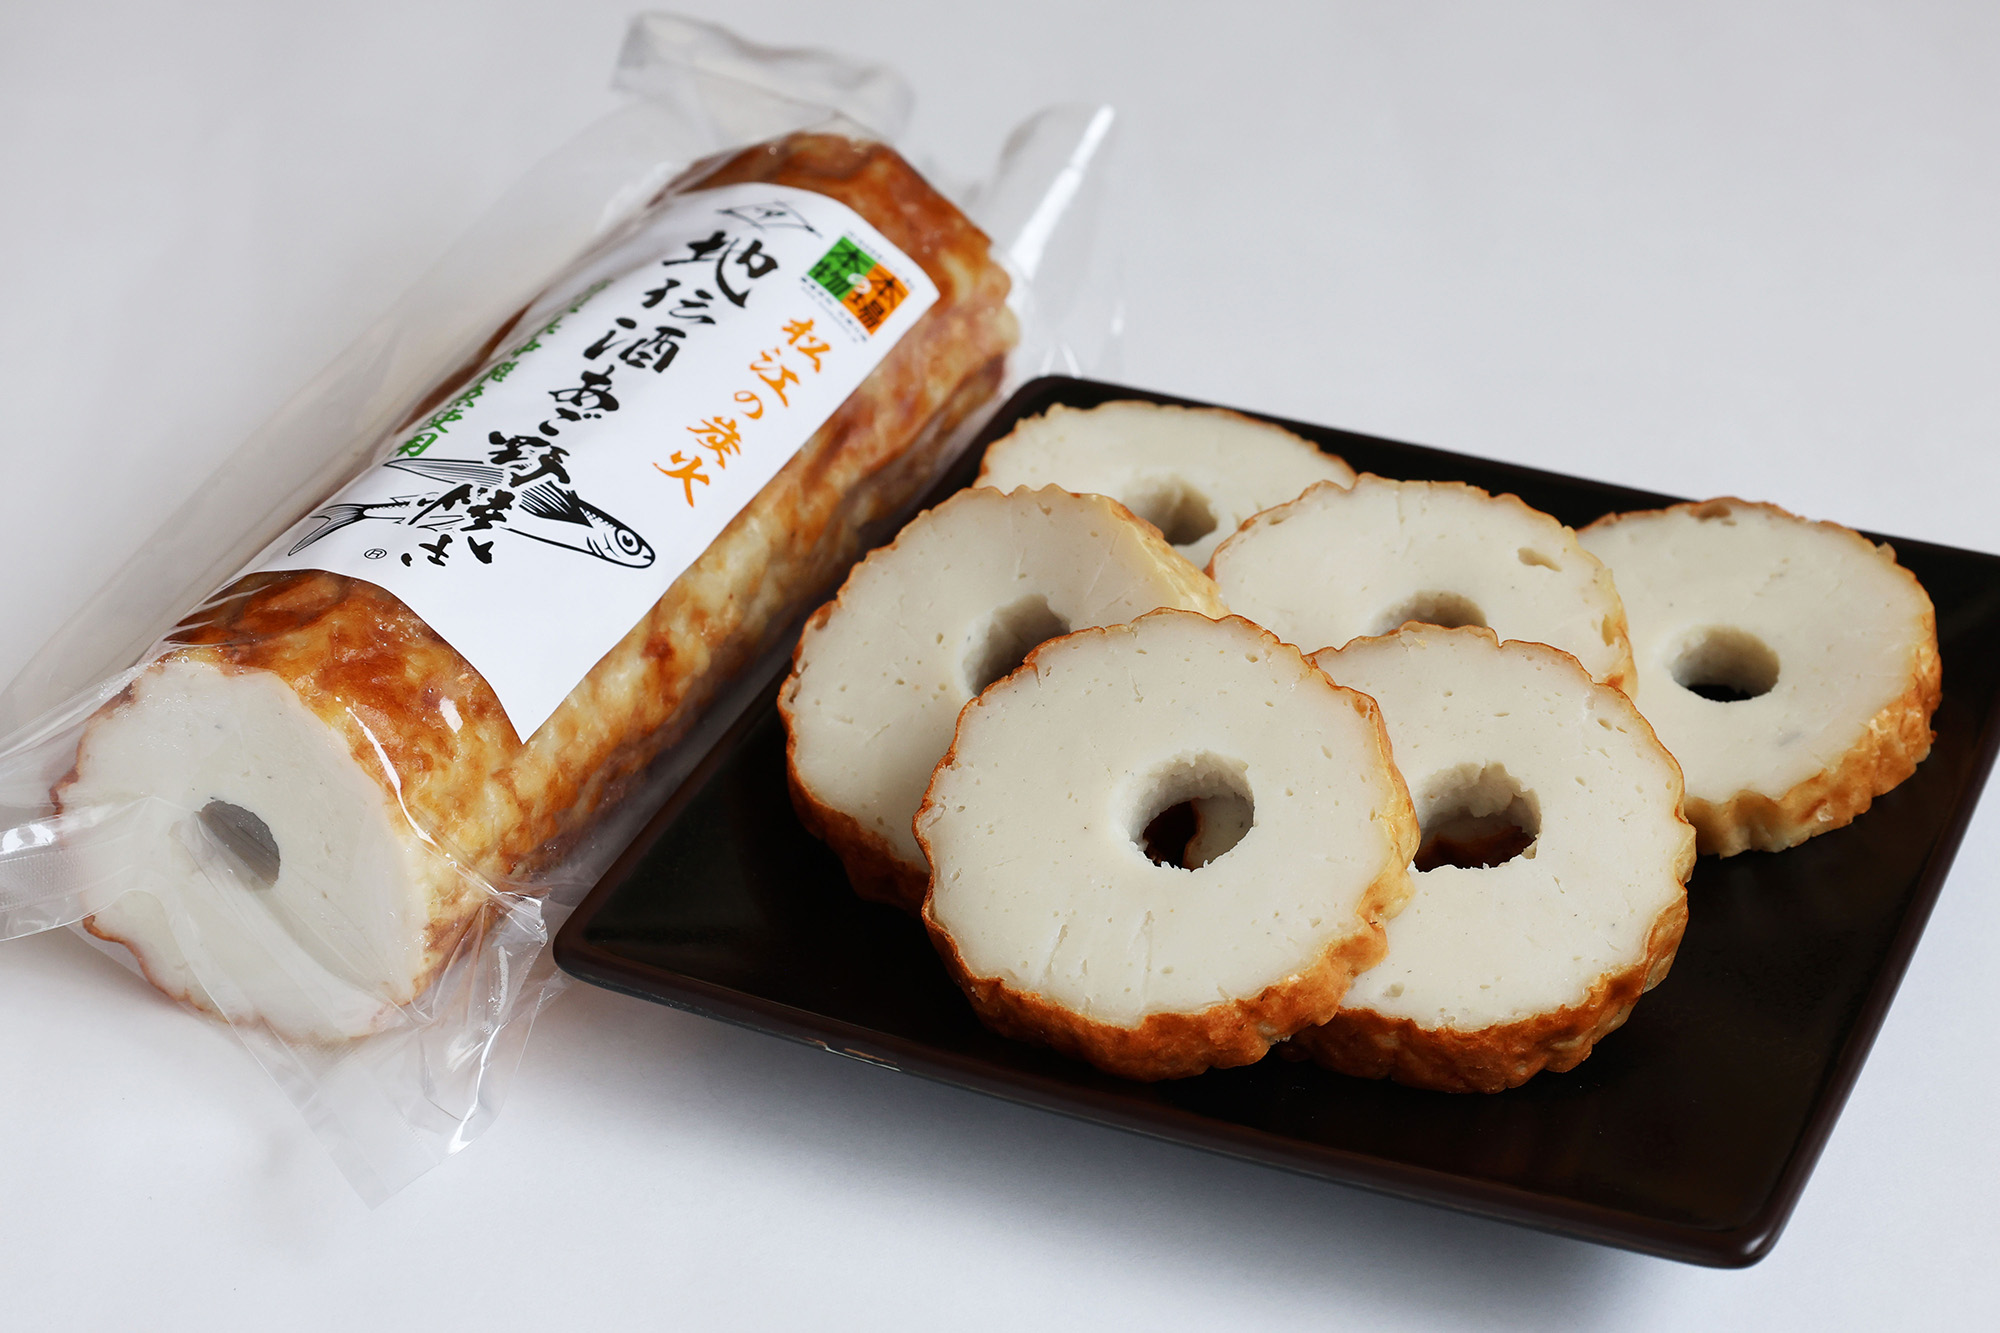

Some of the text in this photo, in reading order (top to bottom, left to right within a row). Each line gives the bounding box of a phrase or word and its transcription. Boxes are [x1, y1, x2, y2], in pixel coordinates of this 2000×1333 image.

[652, 317, 831, 508] 松江の炭火
